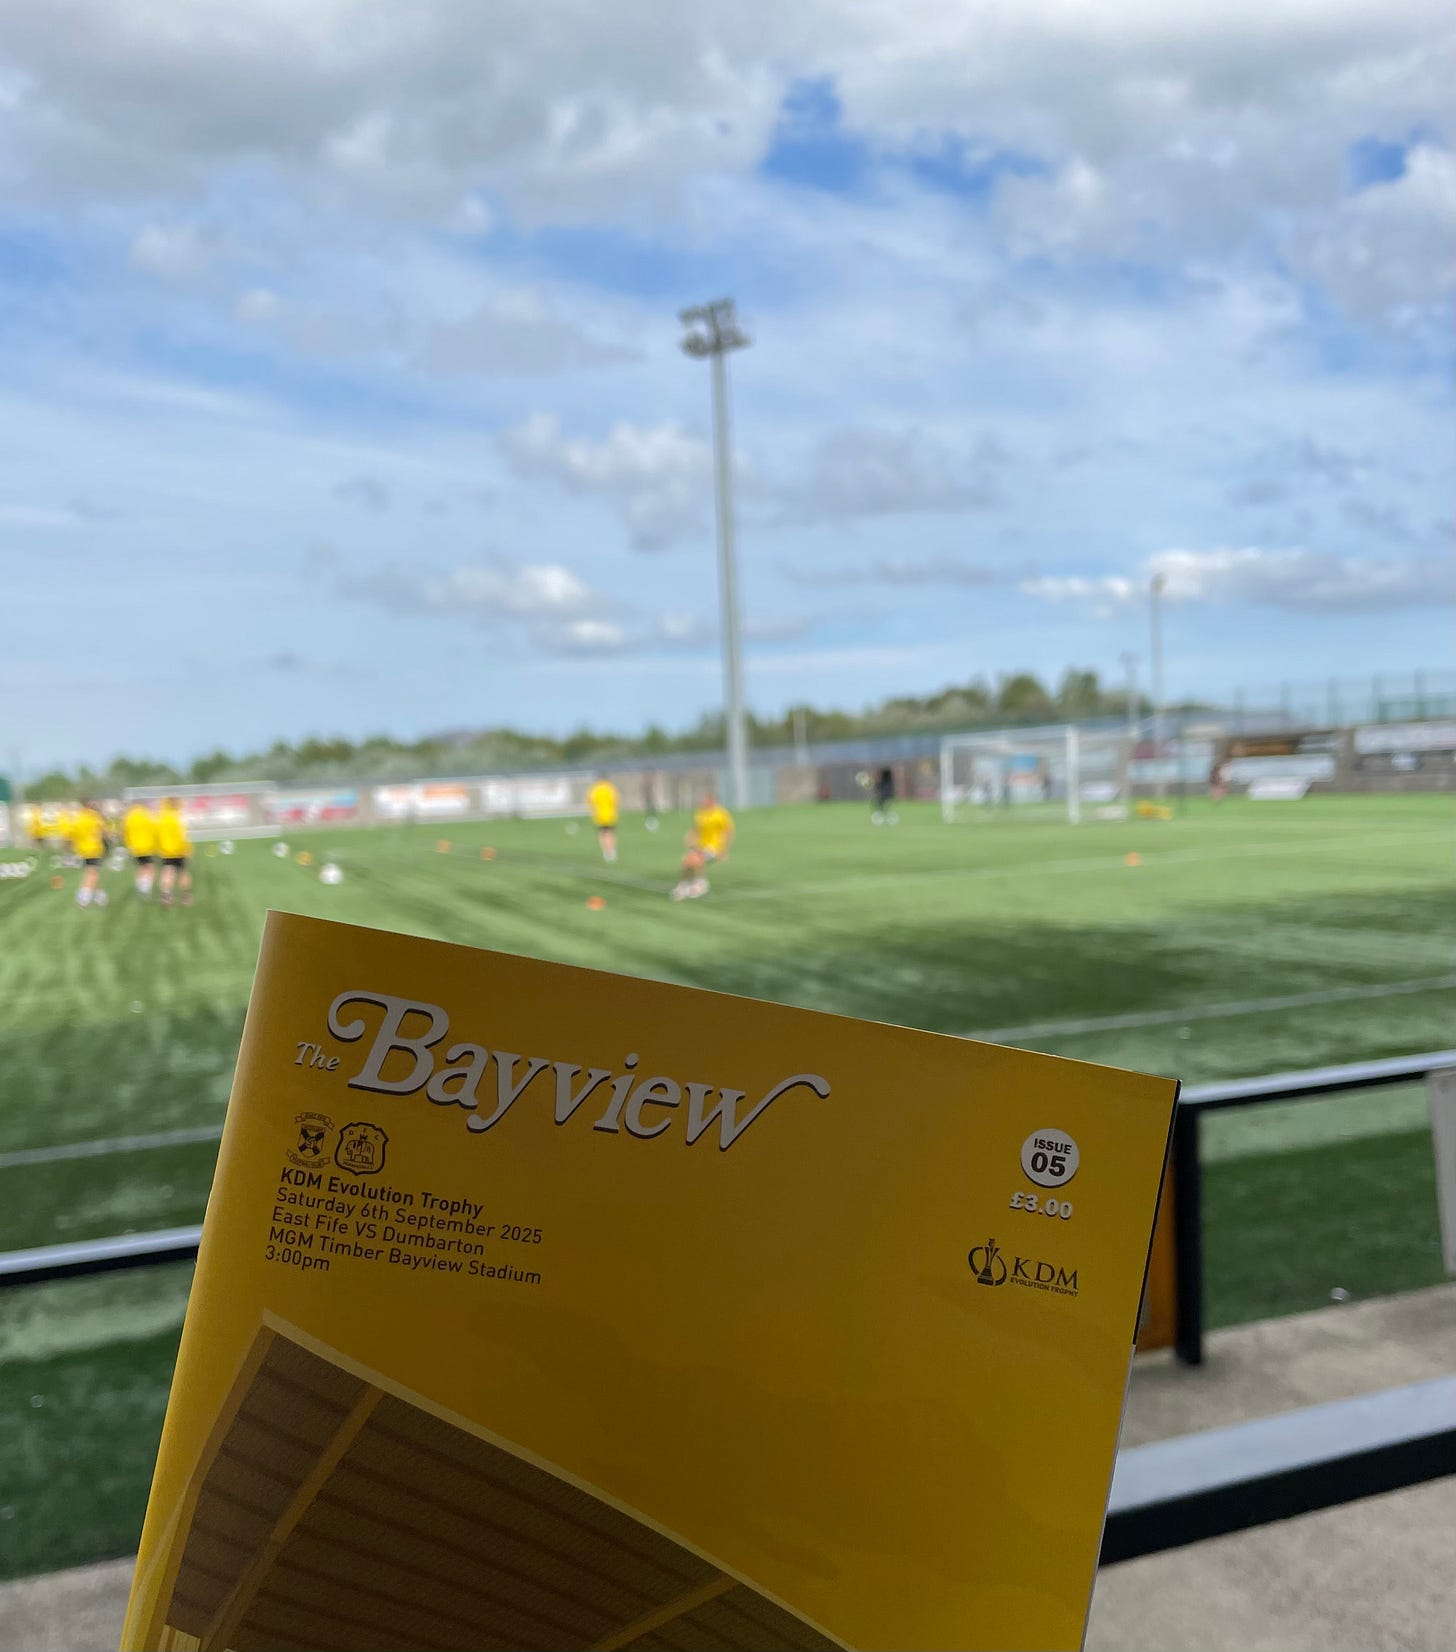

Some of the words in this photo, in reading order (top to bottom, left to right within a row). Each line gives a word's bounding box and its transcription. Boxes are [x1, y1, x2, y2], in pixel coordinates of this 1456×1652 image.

[293, 1040, 341, 1072] The
[326, 989, 831, 1153] Bayview
[1034, 1138, 1072, 1155] ISSUE
[1031, 1152, 1067, 1177] 05
[280, 1167, 322, 1190] KDM
[328, 1177, 414, 1206] Evolution
[421, 1192, 484, 1219] Trophy
[1009, 1191, 1073, 1221] £3.00
[272, 1207, 310, 1228] East
[316, 1215, 348, 1235] Fife
[356, 1221, 377, 1239] VS
[383, 1226, 484, 1256] Dumbarton
[276, 1187, 355, 1218] Saturday
[361, 1200, 389, 1221] 6th
[395, 1208, 495, 1239] September
[500, 1225, 543, 1244] 2025
[265, 1245, 330, 1271] 3:00pm
[269, 1226, 313, 1249] MGM
[320, 1235, 384, 1260] Timber
[388, 1248, 463, 1274] Bayview
[468, 1259, 542, 1285] Stadium
[1010, 1276, 1050, 1291] EVOLUTION
[1051, 1285, 1079, 1297] TROPHY
[1012, 1256, 1079, 1290] KDM
